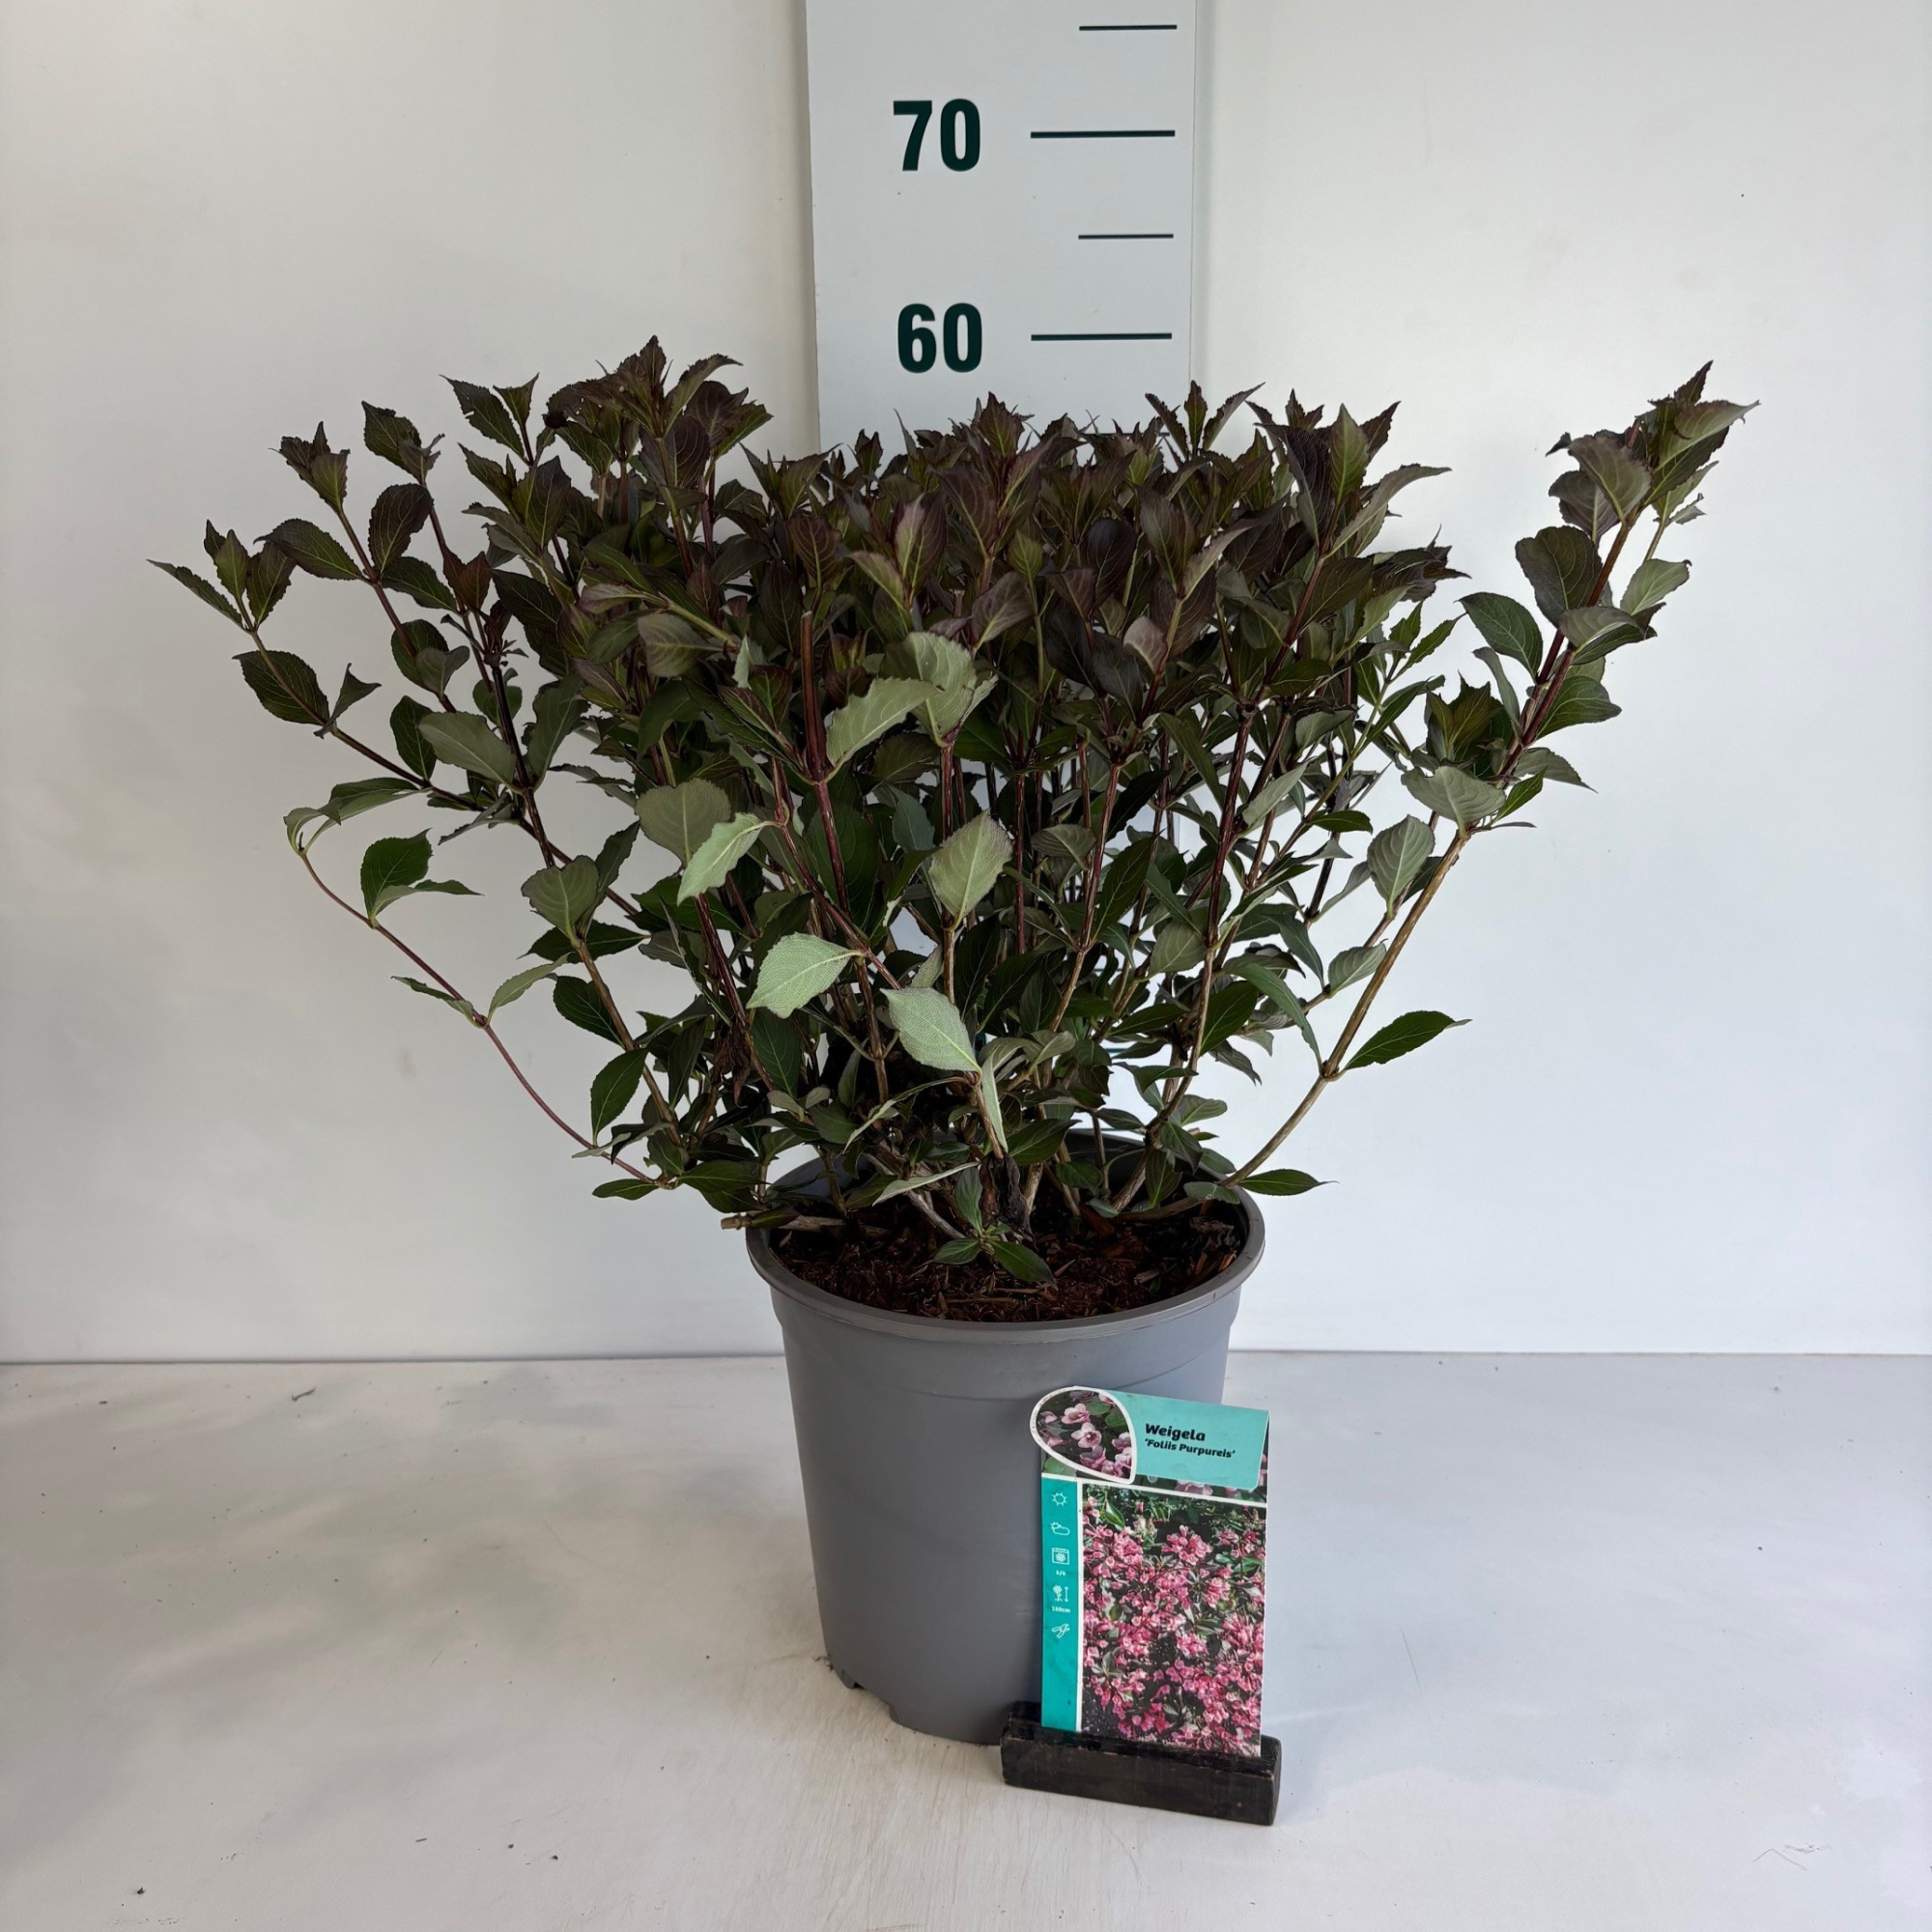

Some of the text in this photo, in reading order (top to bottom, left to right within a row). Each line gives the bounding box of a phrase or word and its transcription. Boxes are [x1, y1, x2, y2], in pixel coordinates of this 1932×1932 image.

[893, 98, 981, 172] 70
[896, 302, 982, 374] 60
[1145, 1423, 1206, 1442] Weigela
